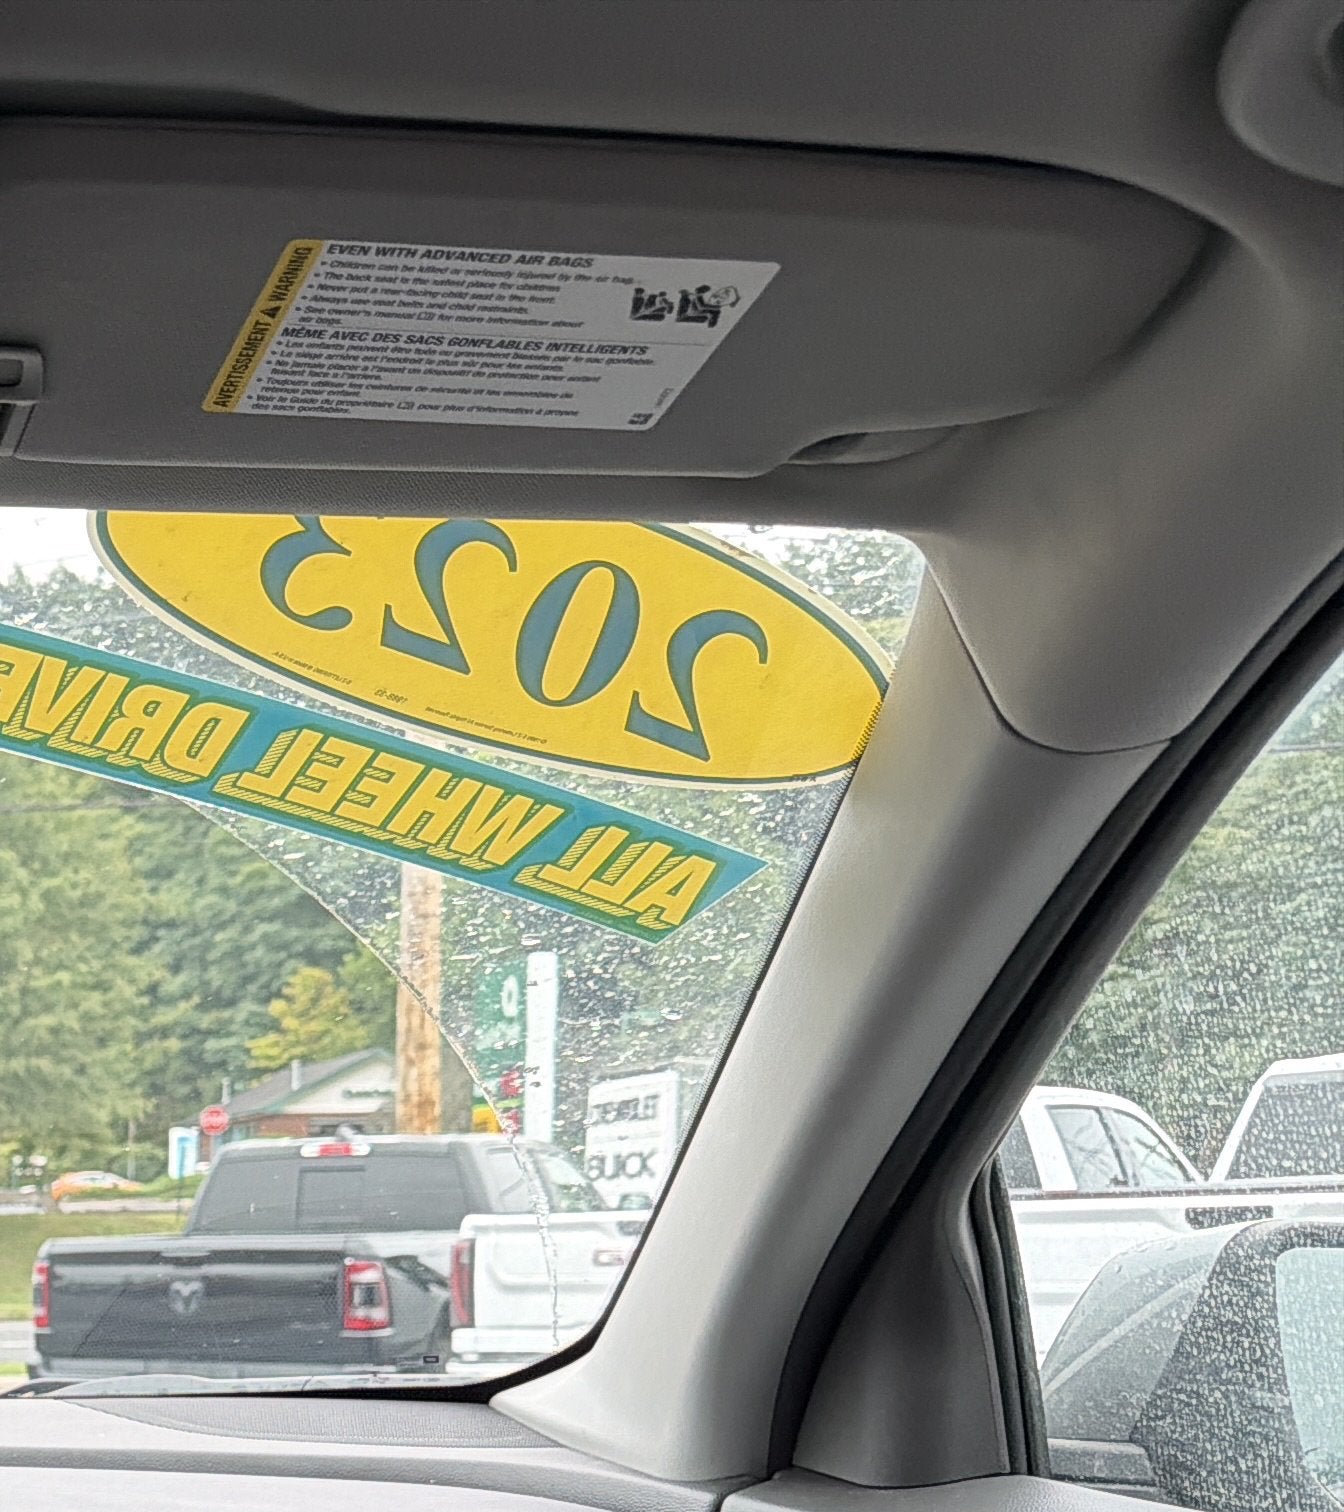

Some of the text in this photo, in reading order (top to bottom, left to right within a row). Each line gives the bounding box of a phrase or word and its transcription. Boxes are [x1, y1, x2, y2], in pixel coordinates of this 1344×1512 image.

[269, 245, 313, 304] WARNING
[327, 243, 594, 268] EVEN WITH ADVANCED AIR BAGS
[280, 325, 327, 339] MÊME
[329, 329, 369, 341] AVEC
[372, 331, 400, 343] DES
[403, 333, 444, 345] SACS
[446, 335, 542, 350] GONFLABLES
[544, 341, 649, 356] INTELLIGENTS
[213, 319, 275, 410] AVERTISSEMENT
